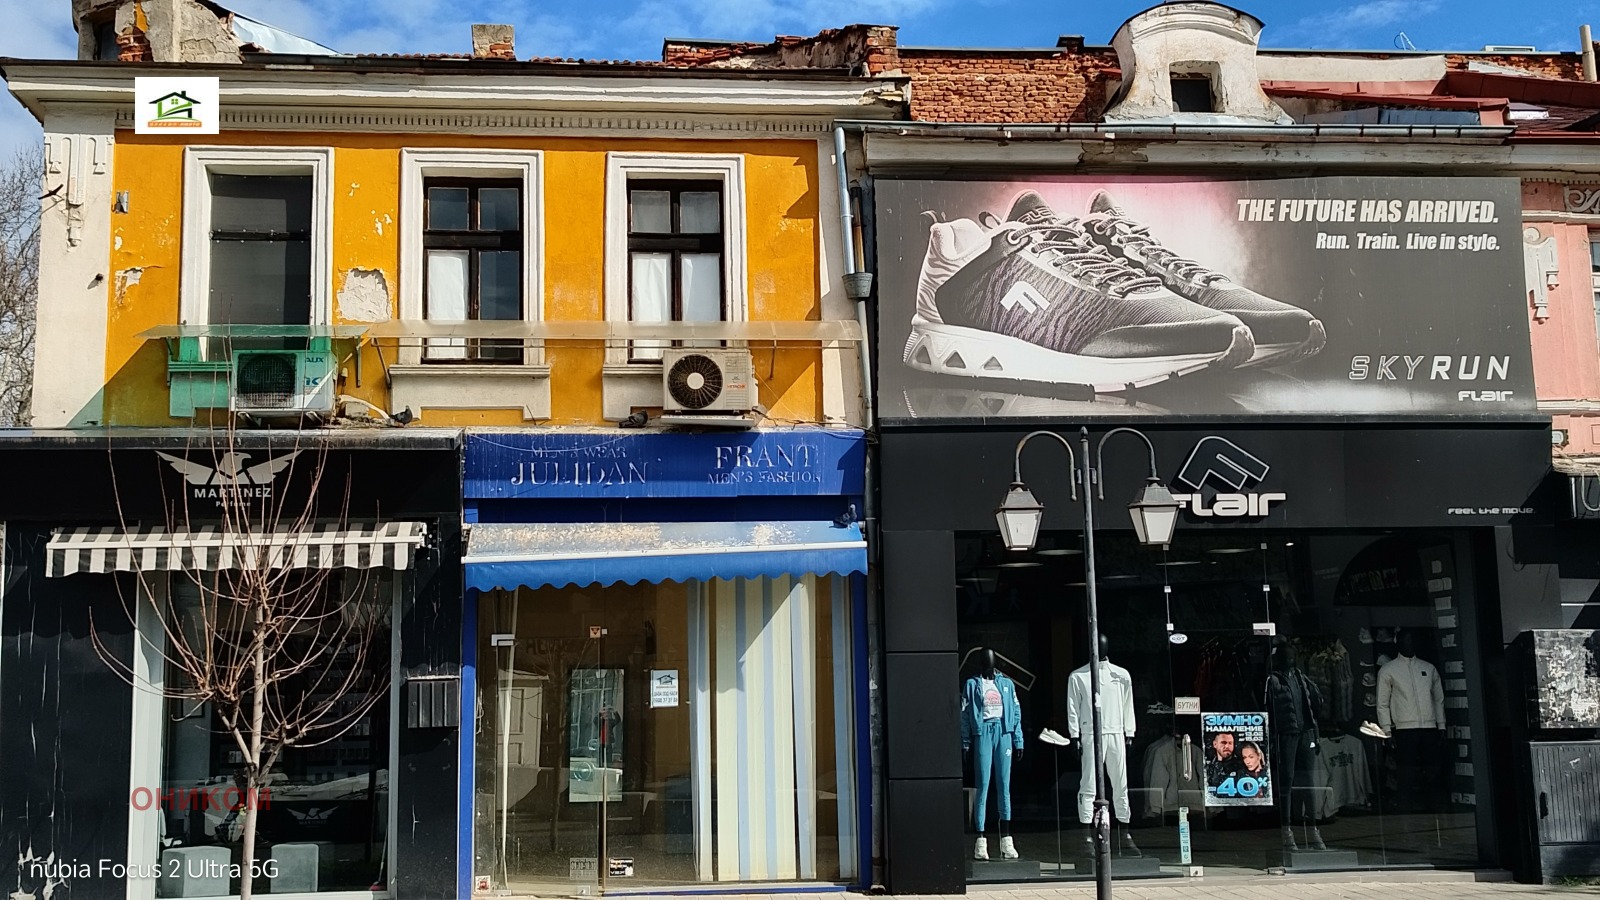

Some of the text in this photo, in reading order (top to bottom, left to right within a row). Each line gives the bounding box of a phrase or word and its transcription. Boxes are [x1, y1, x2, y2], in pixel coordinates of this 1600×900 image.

[1237, 199, 1499, 223] THE FUTURE HAS ARRIVED.
[1316, 232, 1501, 252] Run. Train. Live in style.
[1348, 355, 1510, 381] SKYRUN
[584, 446, 627, 458] WEAR
[714, 444, 816, 469] FRANT
[707, 470, 821, 485] MEN'S FASHION
[1177, 701, 1198, 709] БУТНИ
[1204, 715, 1263, 726] ЗИМНО
